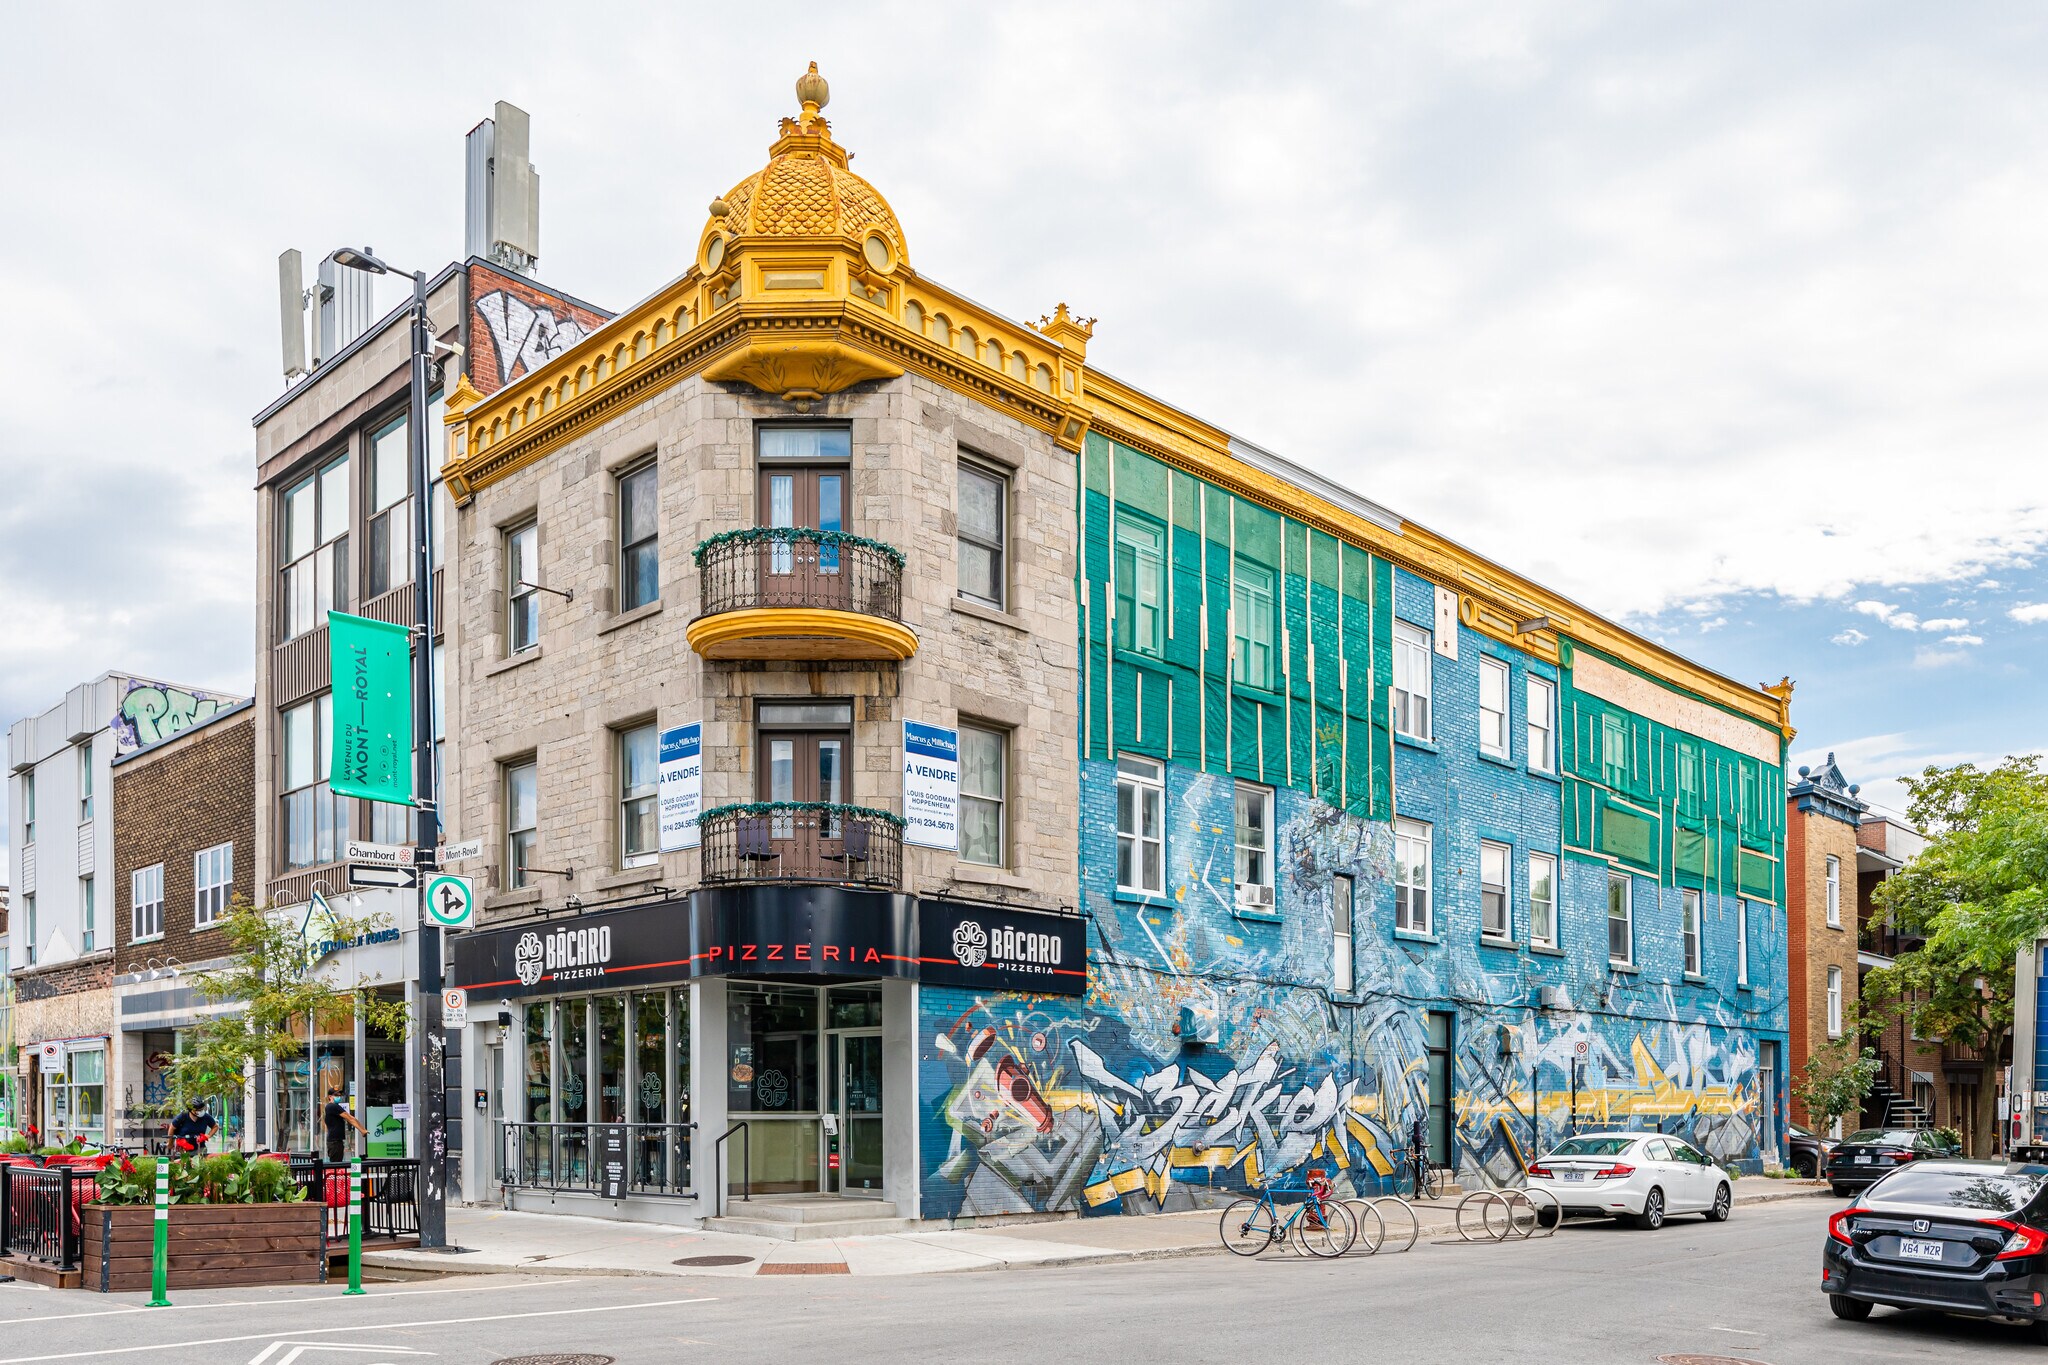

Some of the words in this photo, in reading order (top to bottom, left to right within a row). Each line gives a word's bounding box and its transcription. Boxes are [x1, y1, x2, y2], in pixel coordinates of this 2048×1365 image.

[345, 723, 353, 736] DU
[660, 743, 675, 752] Marcus
[674, 742, 680, 750] &
[679, 736, 700, 747] Millichap
[906, 732, 926, 744] Marcus
[926, 738, 933, 747] &
[932, 737, 956, 752] Millichap
[343, 737, 353, 781] L'AVENUE
[660, 772, 666, 785] À
[667, 765, 700, 782] VENDRE
[906, 761, 913, 774] À
[915, 765, 957, 783] VENDRE
[661, 796, 675, 806] LOUIS
[676, 792, 699, 804] GOODMAN
[906, 789, 924, 799] LOUIS
[925, 793, 956, 804] GOODMAN
[911, 797, 950, 810] HOPPENHEIM
[665, 800, 695, 811] HOPPENHEIM
[662, 824, 674, 834] (514)
[674, 817, 700, 831] 234.5678
[908, 816, 923, 827] (514)
[923, 818, 955, 831] 234.5678
[349, 847, 396, 861] Chambord
[445, 845, 478, 860] Mont-Royal
[365, 928, 400, 946] roues
[991, 925, 1062, 965] BĀCARO
[546, 926, 611, 970] BĀCARO
[708, 943, 881, 963] PIZZERIA
[553, 966, 605, 982] PIZZERIA
[997, 962, 1054, 975] PIZZERIA
[1901, 1243, 1919, 1254] X64
[1923, 1245, 1941, 1256] MZR
